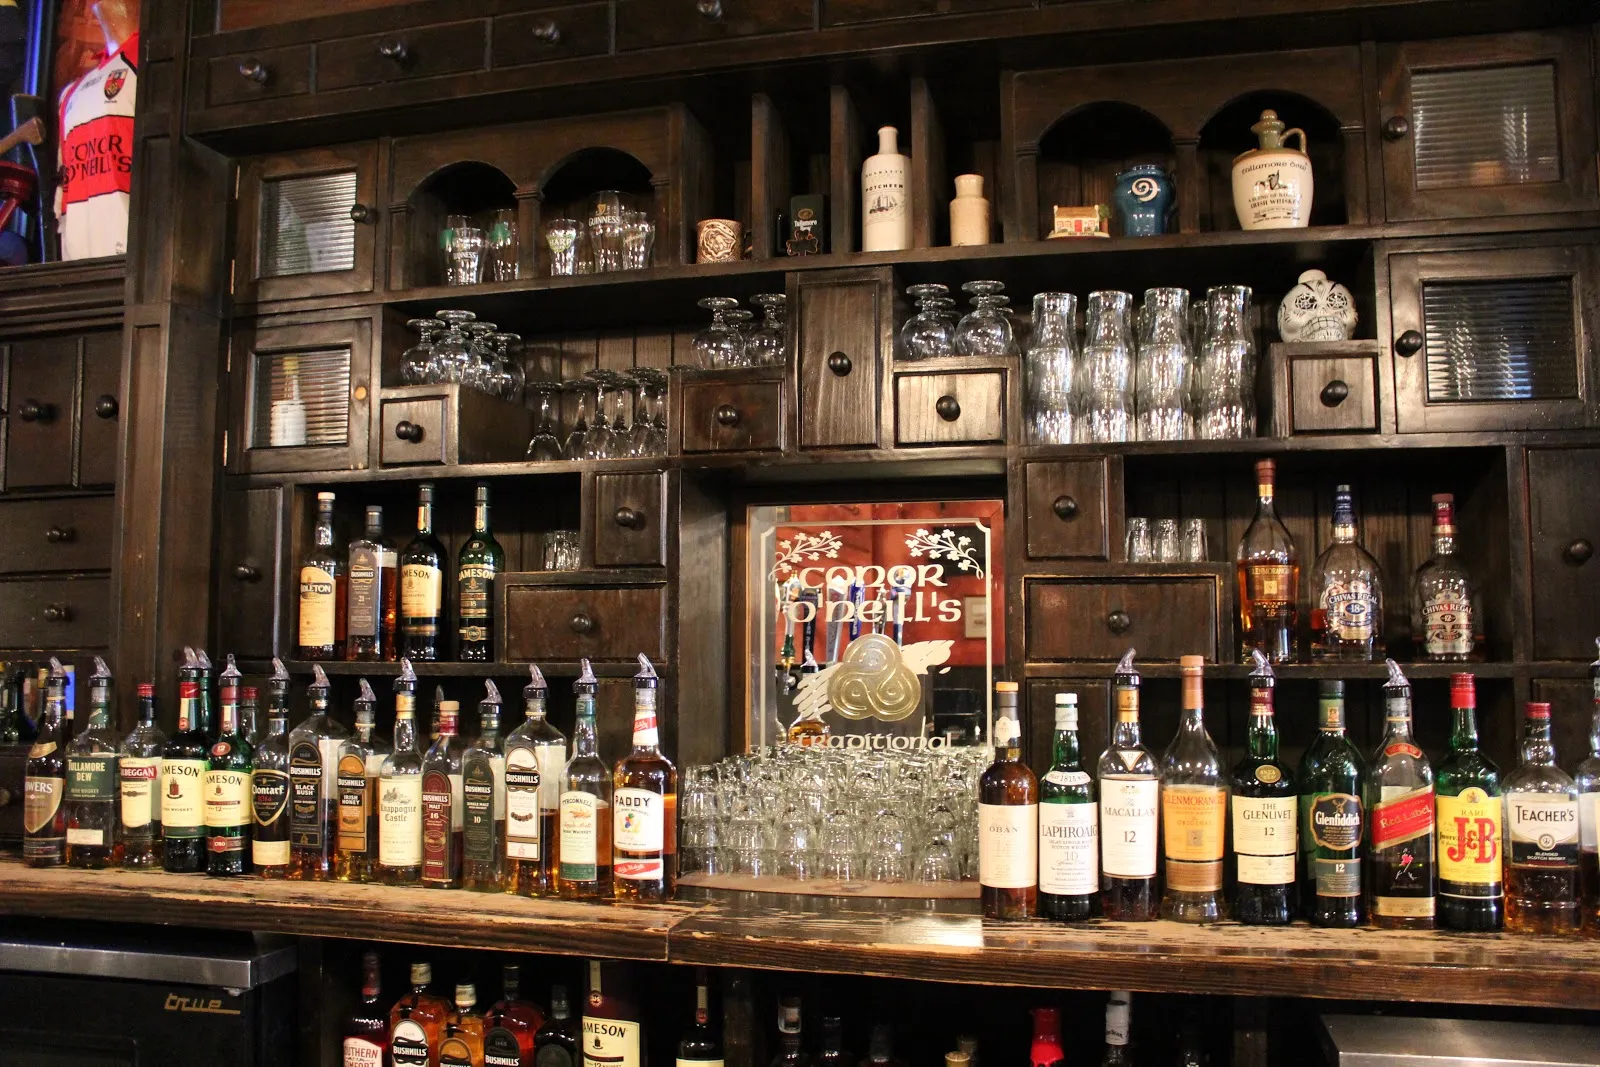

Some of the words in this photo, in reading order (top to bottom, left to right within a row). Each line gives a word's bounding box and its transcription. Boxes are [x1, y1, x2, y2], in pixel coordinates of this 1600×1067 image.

[589, 216, 620, 227] GUINNESS
[458, 568, 496, 581] JAMESON
[1328, 593, 1356, 604] CHIVAS
[1357, 593, 1378, 605] REGAL
[1351, 603, 1361, 613] 18
[1422, 603, 1449, 616] CHIVAS
[1450, 603, 1473, 615] REGAL
[68, 759, 106, 772] TULLAMORE
[290, 766, 321, 776] BUSHMILLS
[76, 772, 93, 782] DEW
[338, 778, 365, 787] BUSHMILLS
[505, 773, 540, 784] BUSHMILLS
[1059, 775, 1077, 783] 1815
[464, 785, 491, 793] BUSHMILLS
[422, 794, 448, 803] BUSHMILLS
[1104, 808, 1156, 817] MACALLAN
[1243, 809, 1292, 820] GLENLIVET
[1380, 815, 1401, 829] Red
[1402, 804, 1433, 821] Label
[1515, 805, 1575, 824] TEACHER'S
[473, 815, 482, 824] 10
[1315, 811, 1360, 826] Glenfiddich
[989, 825, 1019, 833] OBAN
[1264, 826, 1275, 836] 12
[1123, 830, 1137, 843] 12
[1447, 816, 1497, 864] J&B
[1335, 863, 1345, 873] 12
[393, 1045, 427, 1057] BUSHMILLS
[485, 1055, 520, 1066] BUSHMILLS
